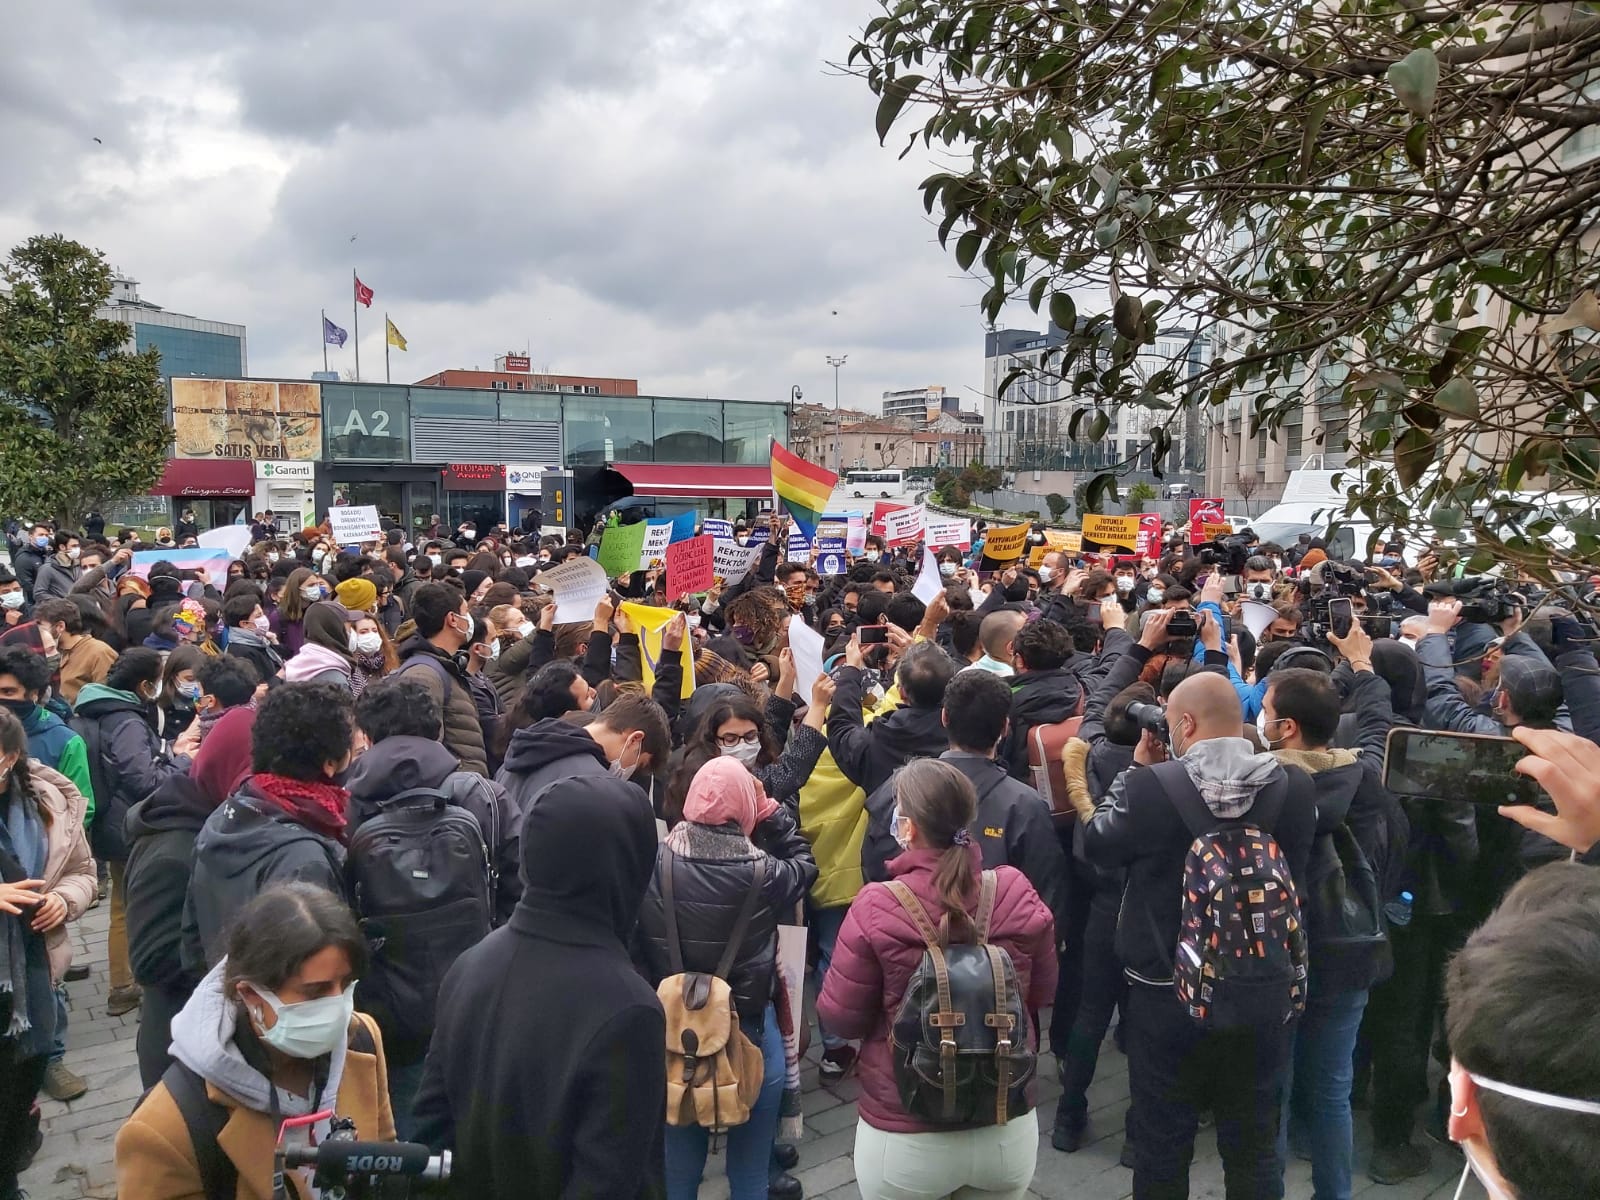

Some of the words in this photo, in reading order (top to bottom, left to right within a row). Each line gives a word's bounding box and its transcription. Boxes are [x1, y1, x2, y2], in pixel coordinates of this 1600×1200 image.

[343, 409, 390, 437] A2
[215, 443, 252, 459] SATIŞ
[275, 465, 310, 475] Garanti
[451, 464, 497, 473] OTOPARK
[522, 471, 540, 479] QNB
[717, 546, 750, 558] REKTÖR
[713, 556, 747, 567] MEKTÖR
[713, 567, 747, 576] EMİYORUZ
[346, 1155, 403, 1171] RØDE
